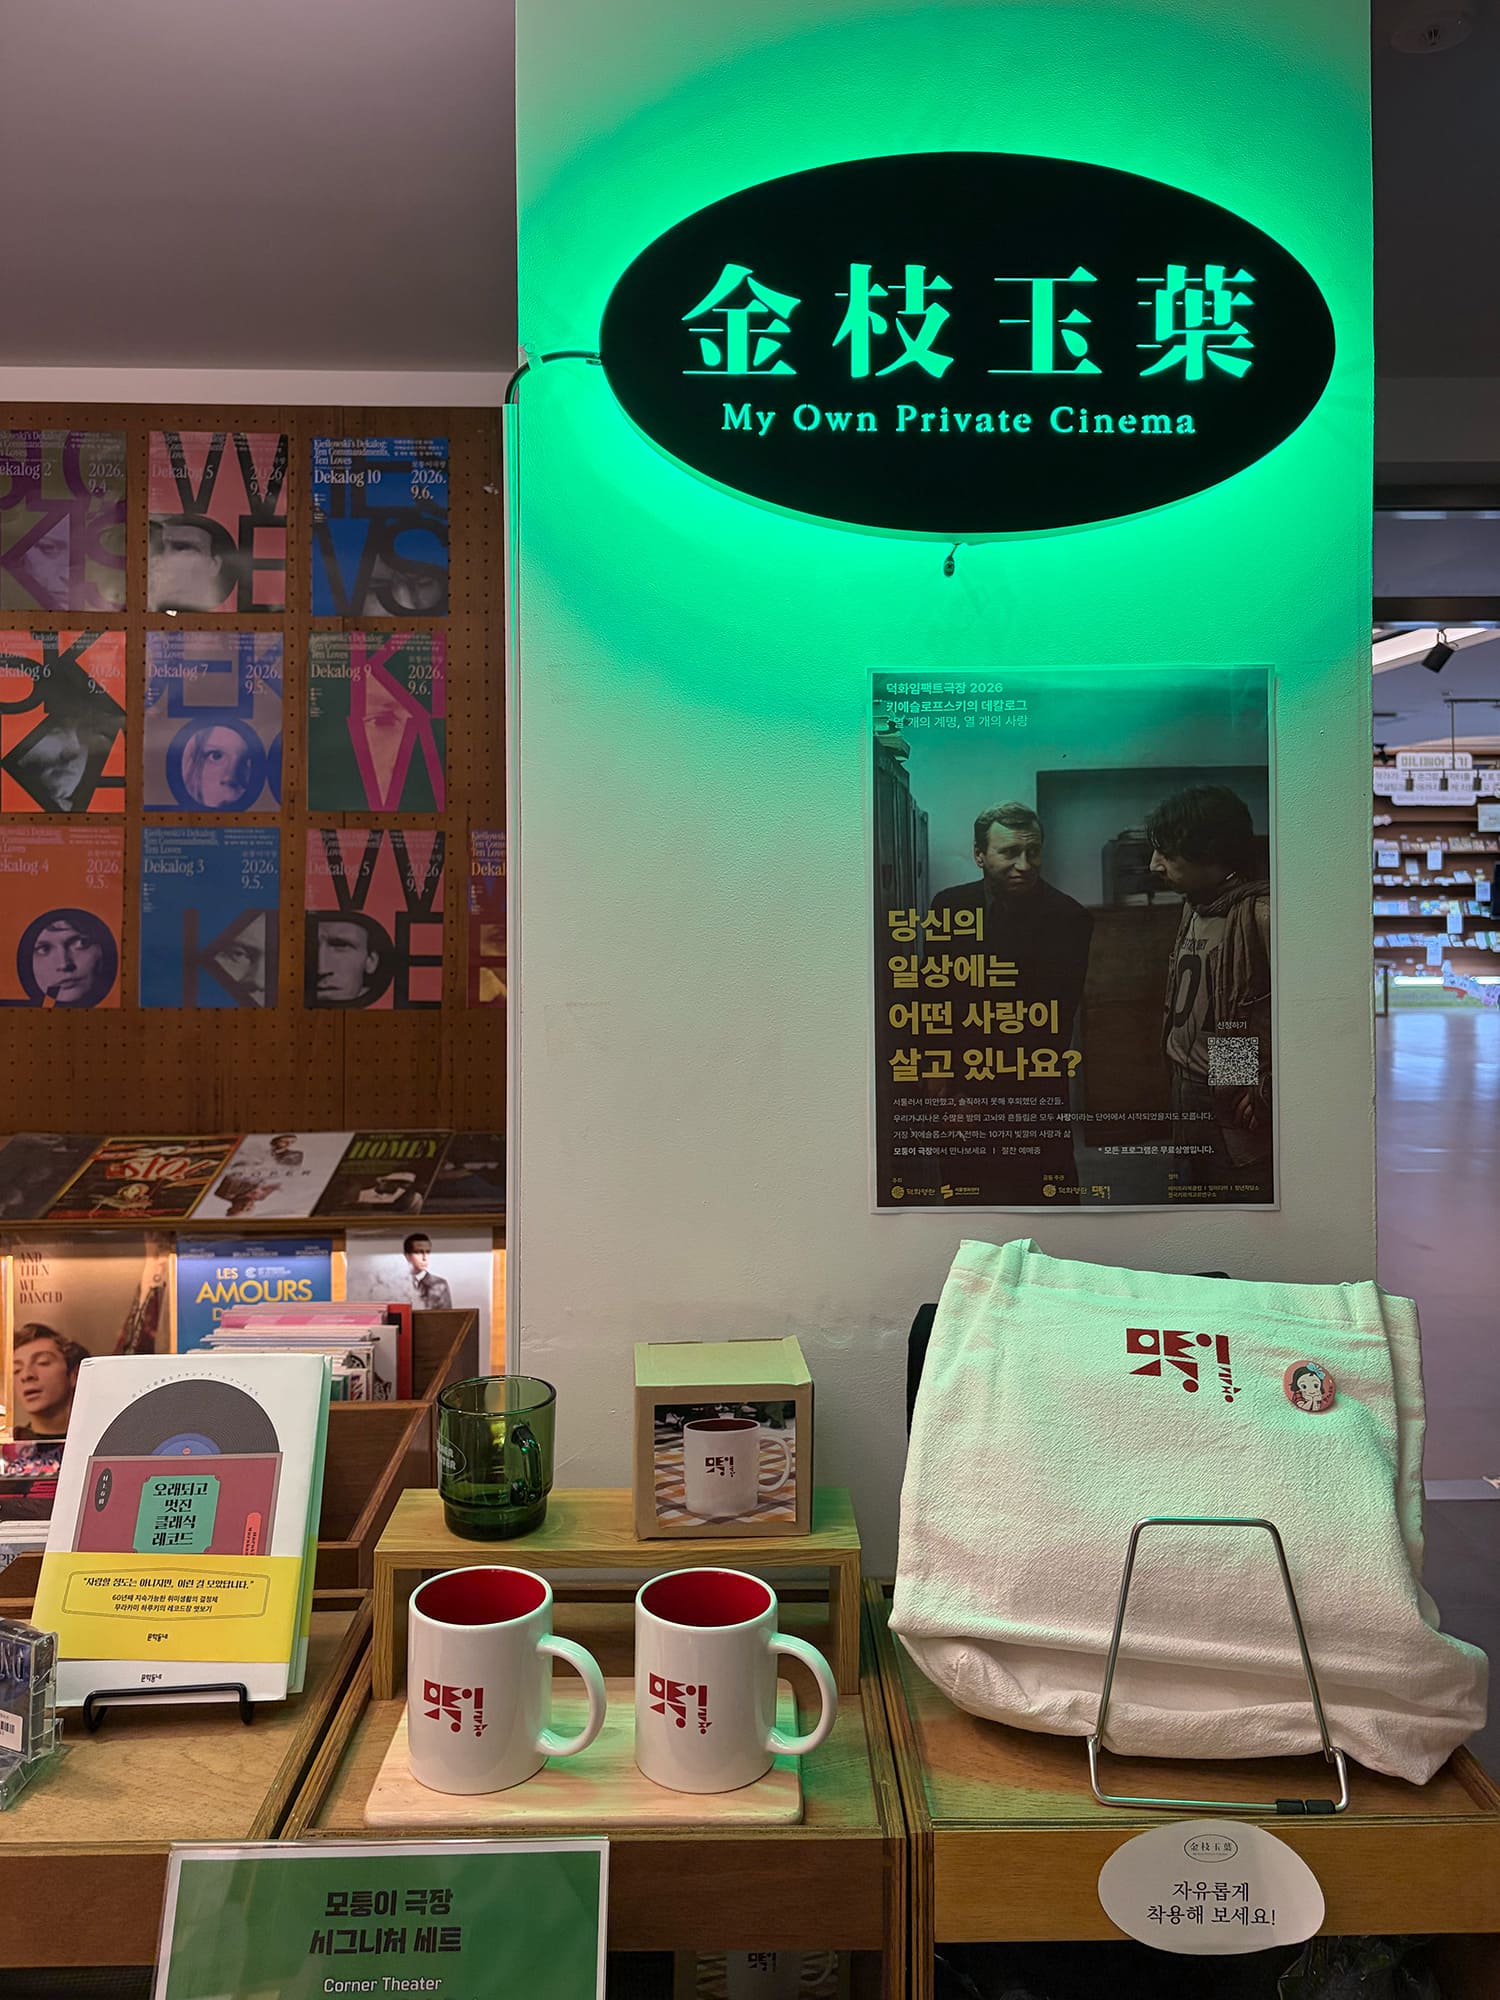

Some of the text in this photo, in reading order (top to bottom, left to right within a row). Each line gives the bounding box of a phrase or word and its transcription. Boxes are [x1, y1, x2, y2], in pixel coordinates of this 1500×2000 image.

[682, 263, 1257, 381] 金枝玉葉
[721, 403, 1197, 438] My Own Private Cinema
[0, 461, 41, 479] ekalog
[206, 464, 214, 479] 5
[314, 469, 381, 487] Dekalog 10
[411, 469, 447, 484] 2026.
[411, 485, 439, 500] 9.6.
[0, 664, 41, 680] ekalog
[149, 663, 208, 681] Dekalog 7
[311, 664, 361, 682] Dekalog
[408, 665, 444, 680] 2026.
[408, 681, 431, 695] 9.6.
[970, 683, 1003, 693] 2026
[981, 700, 1027, 712] 데칼로그
[908, 717, 930, 728] 개의
[964, 716, 975, 728] 열
[979, 716, 1001, 727] 개의
[1005, 715, 1027, 727] 사랑
[0, 858, 40, 876] ekalog
[144, 859, 205, 877] Dekalog 3
[242, 859, 278, 874] 2026.
[361, 861, 370, 876] 5
[472, 862, 506, 876] Dekal
[888, 908, 984, 943] 당신의
[888, 955, 1019, 988] 일상에는
[888, 1000, 1059, 1034] 어떤 사랑이
[888, 1047, 1083, 1082] 살고 있나요?
[20, 1252, 43, 1264] AND
[216, 1267, 239, 1280] LES
[20, 1291, 63, 1304] DANCED
[195, 1279, 313, 1303] AMOURS
[153, 1483, 208, 1496] 오래되고
[165, 1499, 192, 1513] 멋진
[155, 1515, 196, 1530] 클래식
[152, 1532, 193, 1547] 레코드
[1172, 1881, 1250, 1901] 자유롭게
[325, 1888, 454, 1918] 모퉁이 극장
[1147, 1905, 1276, 1926] 착용해 보세요!
[309, 1926, 462, 1955] 시그니처 세트
[323, 1976, 442, 1994] Corner Theater
